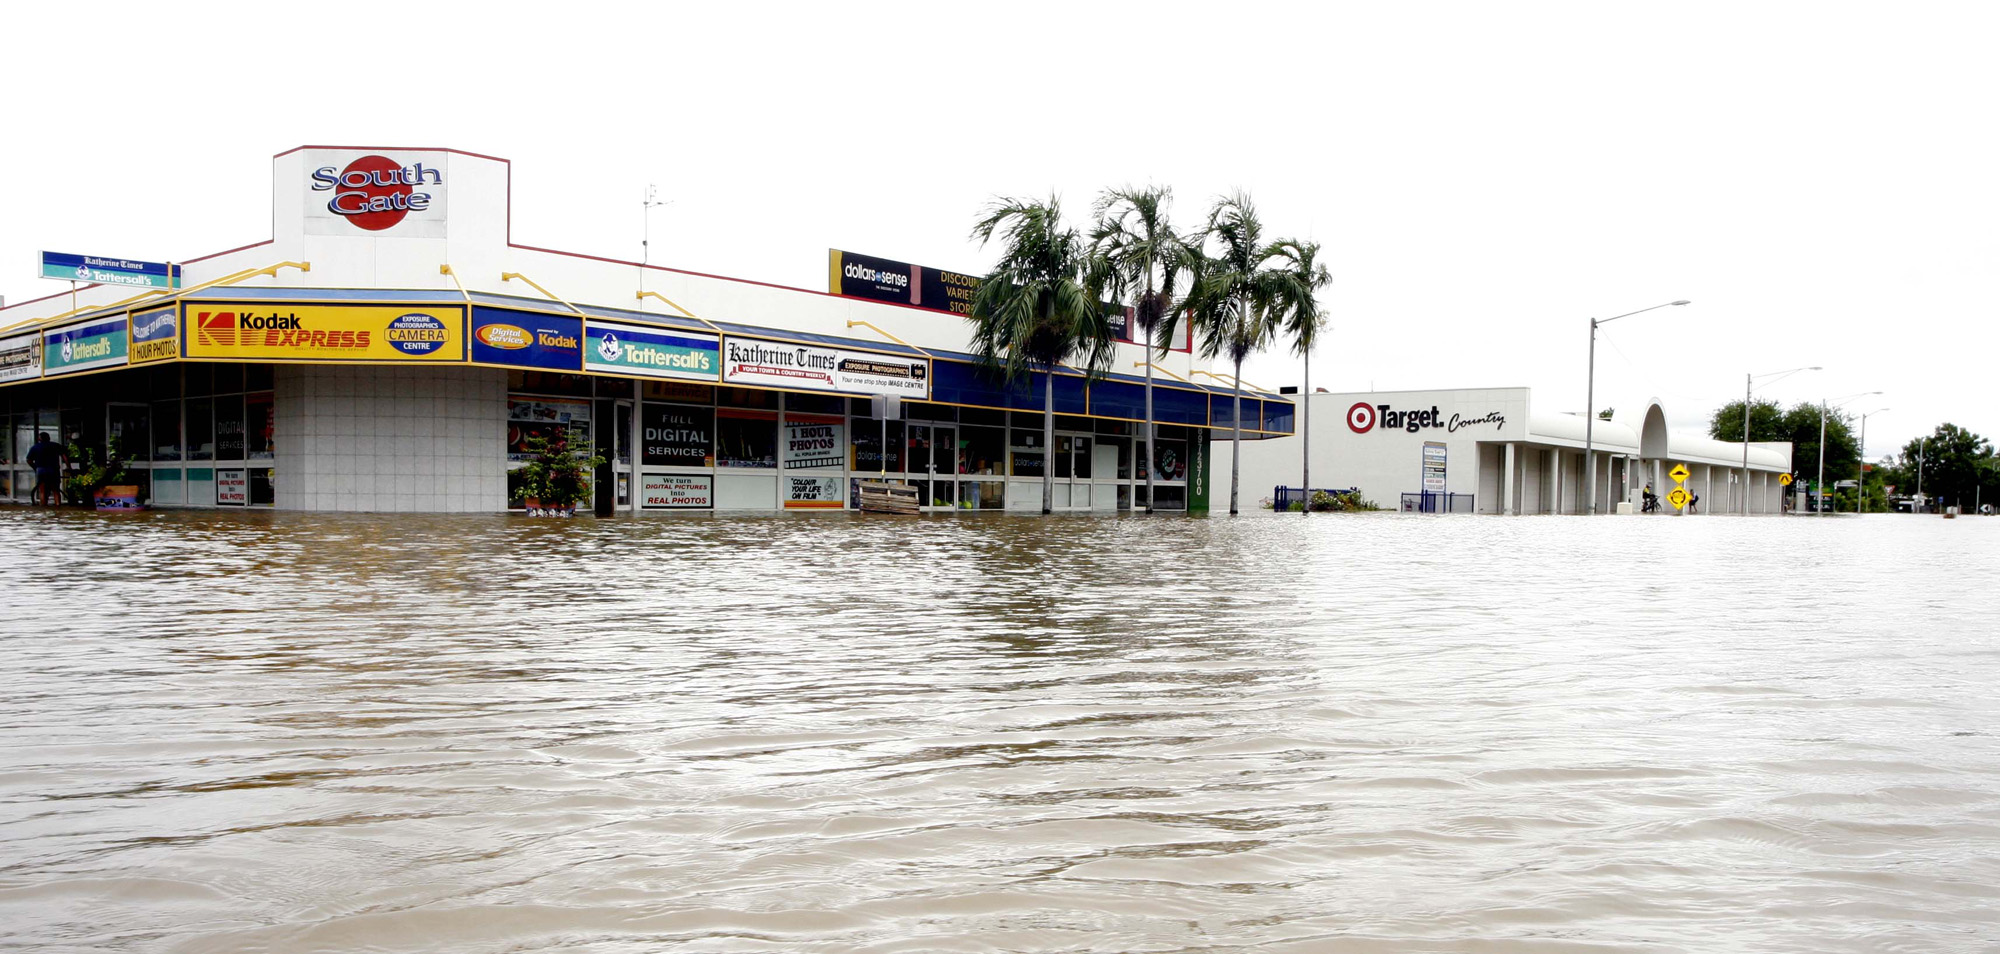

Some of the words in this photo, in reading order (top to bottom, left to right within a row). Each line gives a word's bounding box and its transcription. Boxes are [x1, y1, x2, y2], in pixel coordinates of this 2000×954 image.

[312, 162, 442, 191] South
[328, 191, 432, 216] Gate
[84, 256, 120, 268] Katherine
[120, 260, 144, 270] Times
[93, 270, 152, 286] Tattersall's
[845, 262, 876, 282] dollars
[882, 271, 908, 287] sense
[946, 286, 974, 300] VARIET
[240, 312, 302, 330] Kodak
[264, 330, 370, 348] EXPRESS
[389, 330, 444, 340] CAMERA
[488, 334, 524, 344] Services
[492, 327, 521, 338] Digital
[72, 336, 110, 360] Tattersall's
[538, 333, 577, 348] Kodak
[136, 344, 152, 360] HOUR
[154, 340, 176, 358] PHOTOS
[624, 344, 710, 370] Tattersall's
[728, 342, 794, 366] Katherine
[796, 348, 836, 370] Times
[845, 362, 870, 370] EXPOSURE
[872, 364, 909, 375] PHOTOGRAPHICS
[662, 414, 694, 424] FULL
[1448, 411, 1506, 433] Country
[218, 421, 244, 434] DIGITAL
[792, 428, 796, 438] 1
[801, 427, 834, 438] HOUR
[646, 428, 709, 443] DIGITAL
[648, 446, 706, 457] SERVICES
[789, 439, 834, 451] PHOTOS
[857, 450, 876, 460] dollars
[880, 453, 897, 462] snse
